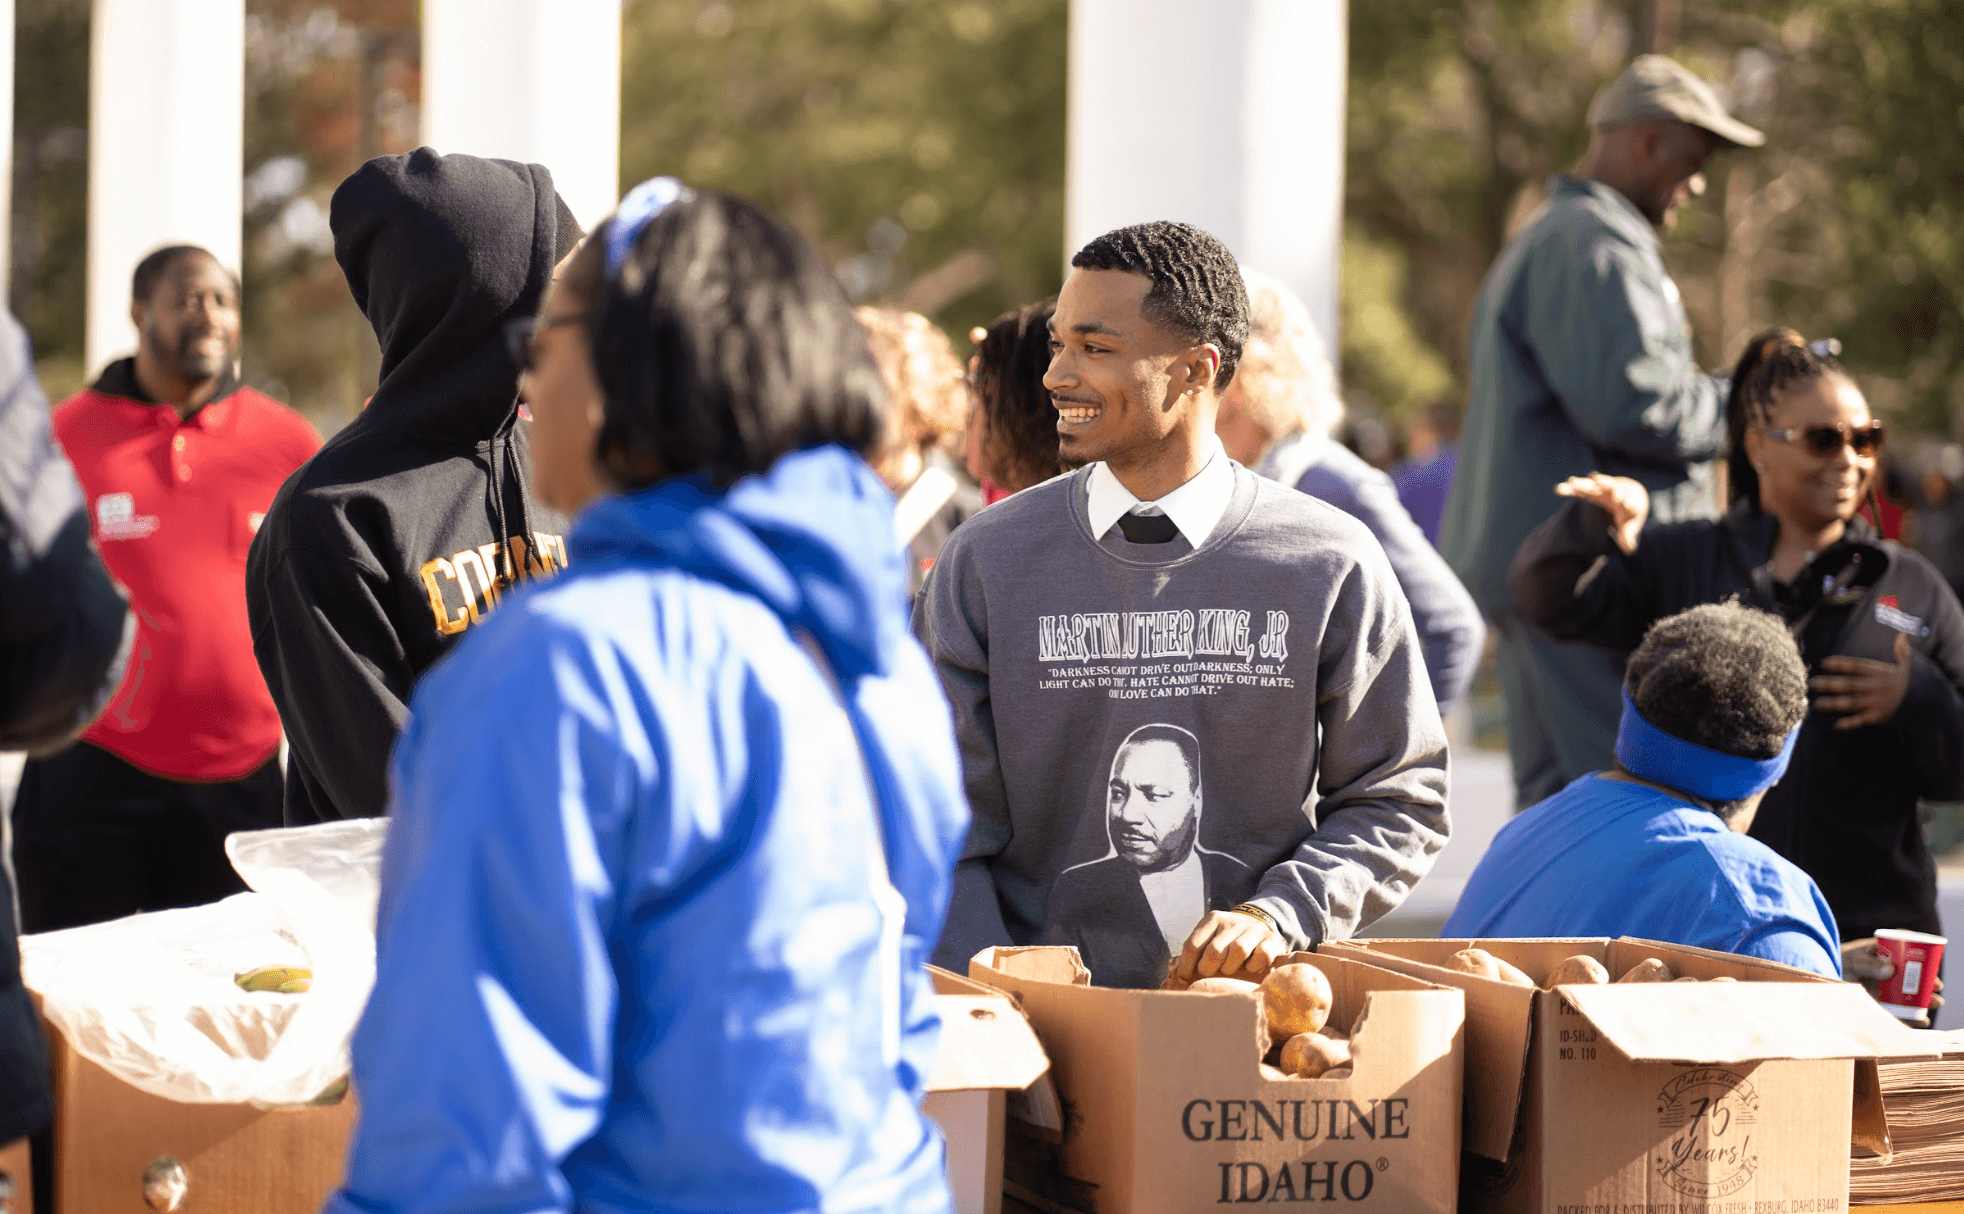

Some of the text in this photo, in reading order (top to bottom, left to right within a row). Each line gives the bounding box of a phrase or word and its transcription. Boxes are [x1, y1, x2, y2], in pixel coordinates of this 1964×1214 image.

[1039, 612, 1121, 664] MARTIN
[1195, 609, 1254, 663] KING,
[1259, 610, 1289, 662] JR
[1048, 666, 1110, 678] "DARKNESS
[1140, 663, 1171, 675] DRIVE
[1255, 664, 1286, 675] ONLY
[1039, 673, 1295, 689] LIGHT CAN DO TT. HATE CANNOT DRIVE OUT HATE;
[1120, 688, 1148, 699] LOVE
[1150, 687, 1172, 698] CAN
[1175, 687, 1189, 697] DO
[1560, 1047, 1597, 1060] NO. 110
[1181, 1098, 1410, 1141] GENUINE
[1690, 1097, 1730, 1137] 75
[1671, 1135, 1750, 1168] Years!
[1676, 1175, 1744, 1195] Since 1948
[1725, 1202, 1747, 1214] FRESH
[1791, 1199, 1815, 1214] IDAHO
[1817, 1198, 1839, 1213] 83440
